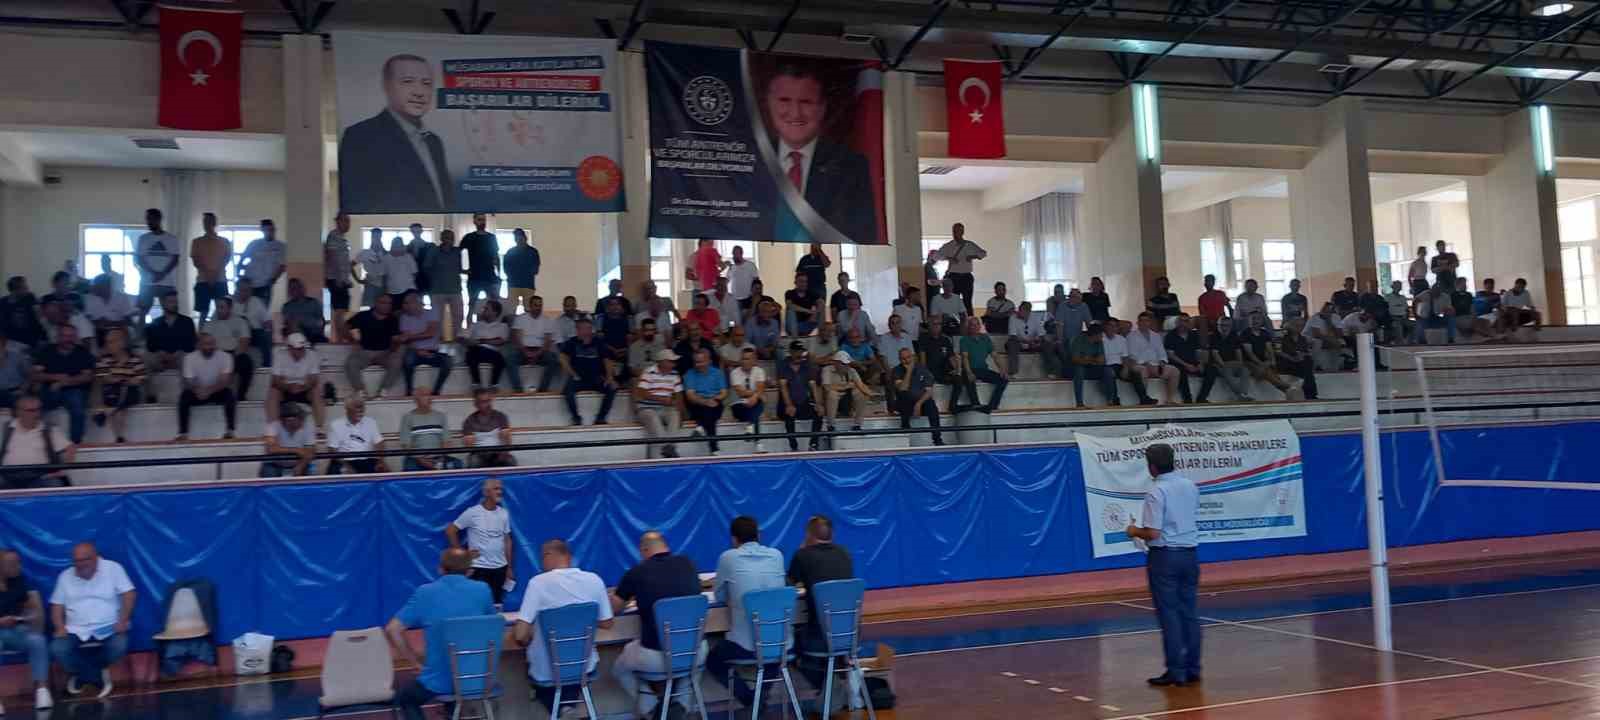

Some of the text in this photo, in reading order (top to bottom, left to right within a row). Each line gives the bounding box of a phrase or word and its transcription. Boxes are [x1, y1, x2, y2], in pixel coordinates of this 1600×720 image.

[446, 94, 533, 108] BAŞARILAR
[1095, 450, 1121, 464] TÜM
[1217, 440, 1230, 452] VE
[1231, 438, 1288, 451] HAKEMLERE
[1201, 455, 1242, 470] DİLERİM
